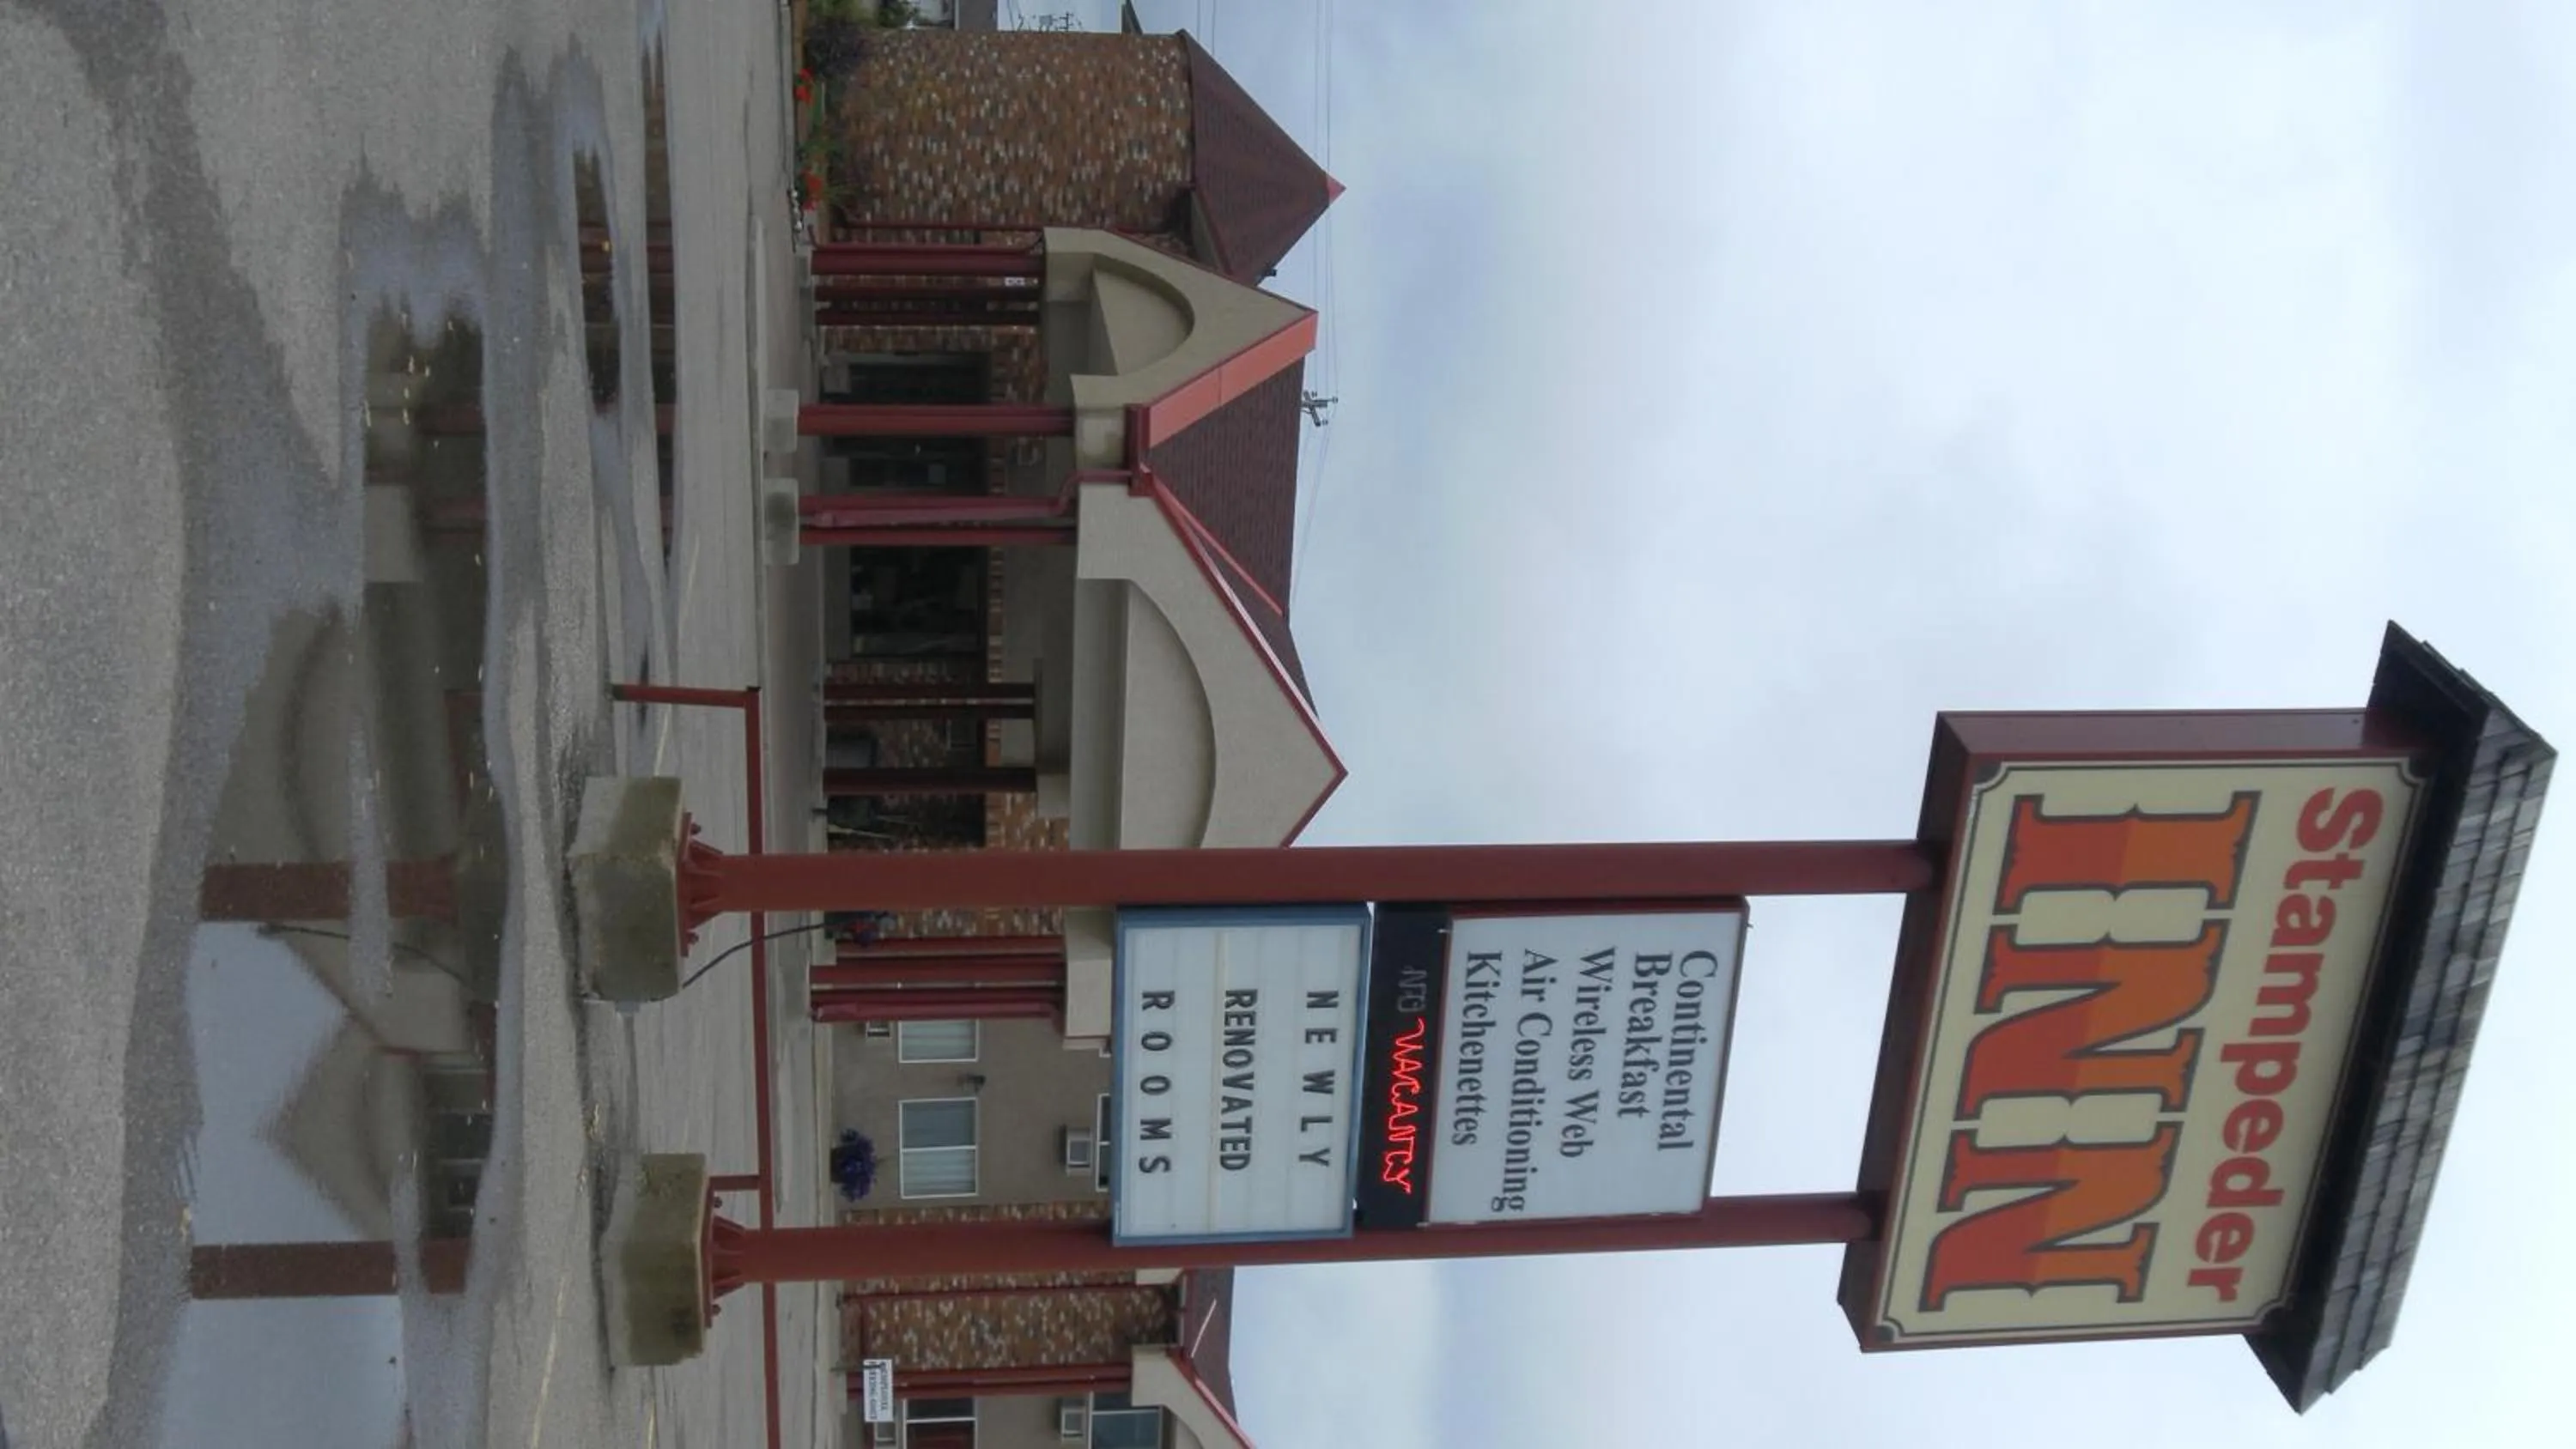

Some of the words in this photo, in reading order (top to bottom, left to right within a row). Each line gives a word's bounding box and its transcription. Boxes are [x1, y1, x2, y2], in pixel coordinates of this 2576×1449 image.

[1452, 950, 1503, 1146] Kitchenettes
[1520, 949, 1559, 1003] Air
[1567, 946, 1615, 1082] Wireless
[1617, 951, 1673, 1119] Breakfast
[1657, 949, 1717, 1151] Continental
[1918, 790, 2262, 1313] INN
[2187, 785, 2384, 1302] Stampeder
[1139, 990, 1176, 1174] ROOMS
[1220, 988, 1258, 1171] RENOVATED
[1298, 990, 1340, 1168] NEWLY
[1382, 1016, 1425, 1194] VACANCY
[1491, 1012, 1552, 1213] Conditioning
[1559, 1090, 1600, 1159] Web
